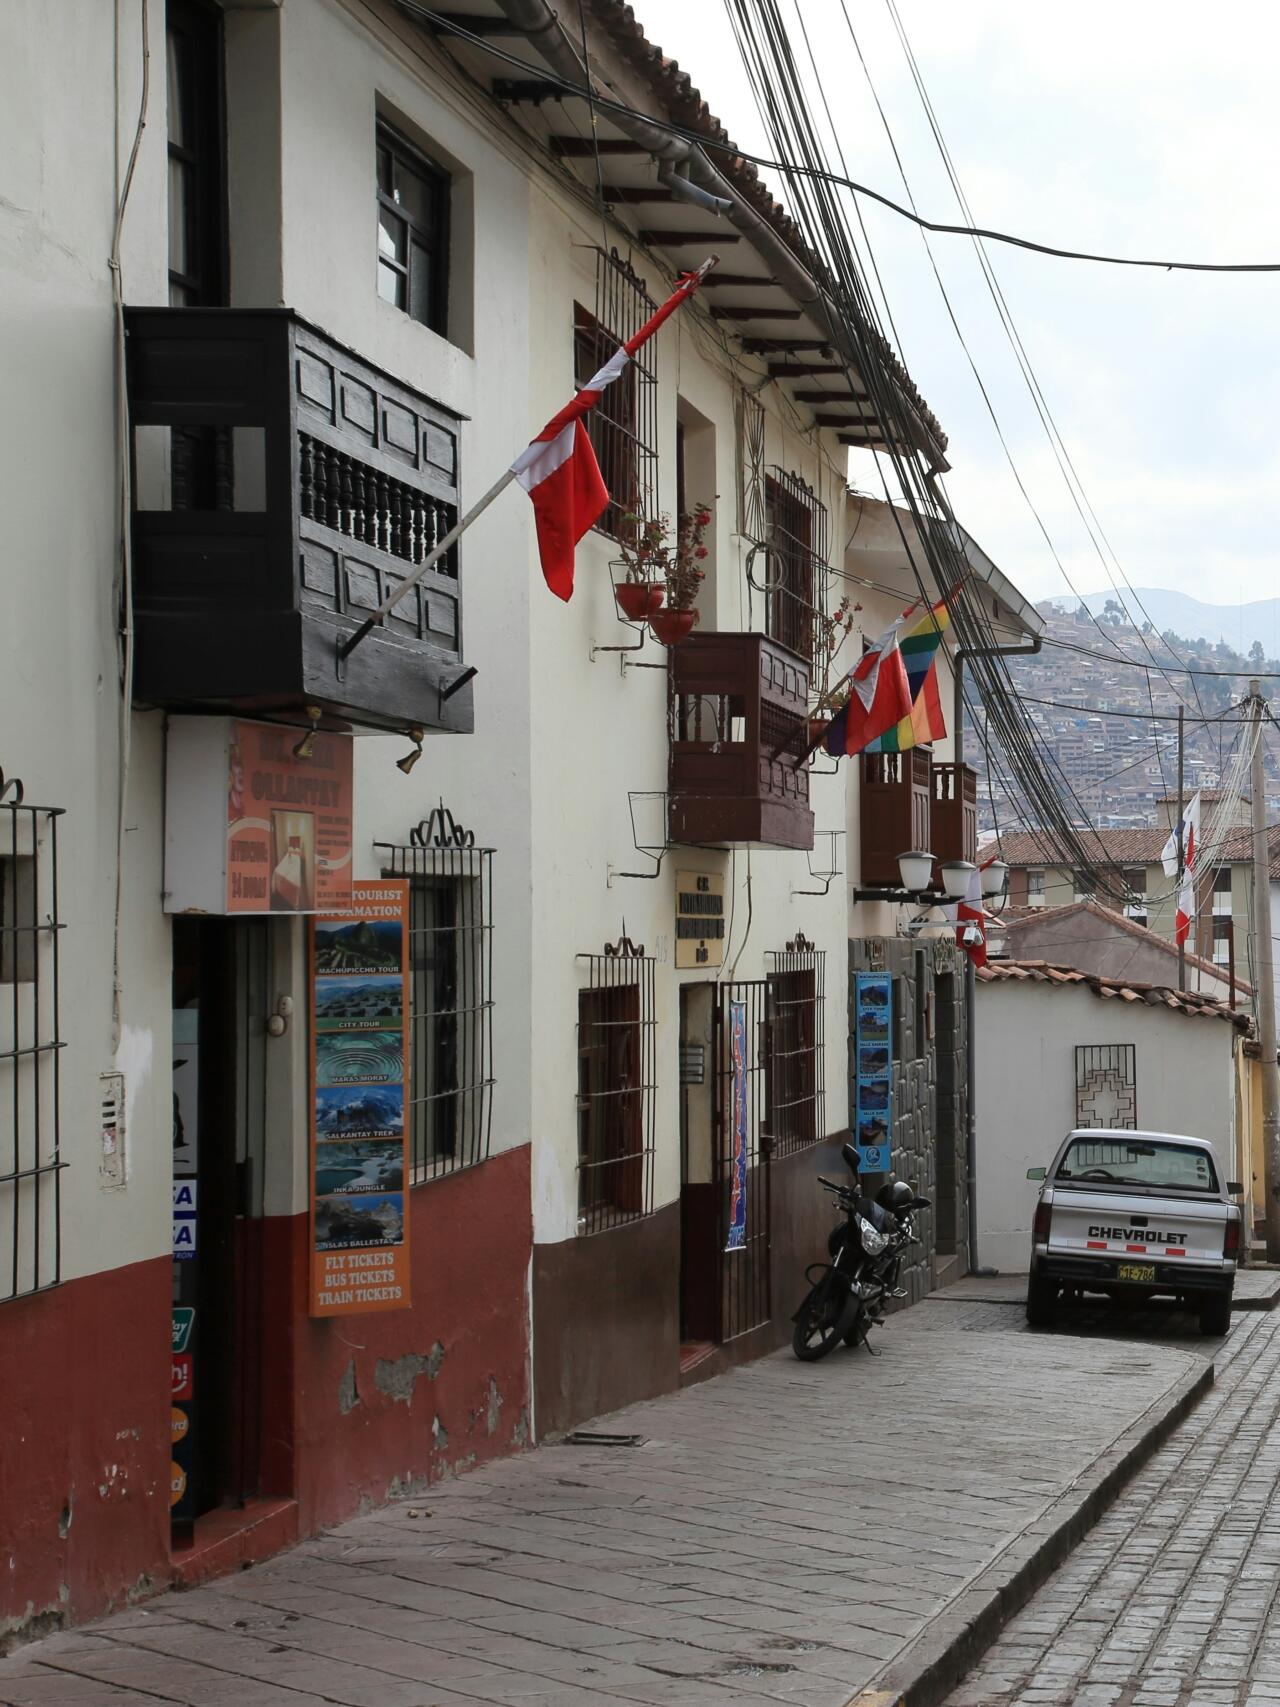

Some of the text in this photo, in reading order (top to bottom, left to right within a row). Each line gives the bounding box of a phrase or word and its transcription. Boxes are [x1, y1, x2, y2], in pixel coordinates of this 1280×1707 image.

[352, 890, 403, 900] TOURIST
[318, 966, 376, 974] MACHUPICCHU
[326, 1131, 371, 1139] SALKANTAY
[354, 1184, 386, 1192] JUNGLE
[1087, 1226, 1188, 1245] CHEVROLET
[325, 1241, 349, 1249] ISLAS
[325, 1252, 394, 1269] FLY TICKETS
[325, 1269, 395, 1288] BUS TICKETS
[319, 1286, 402, 1305] TRAIN TICKETS
